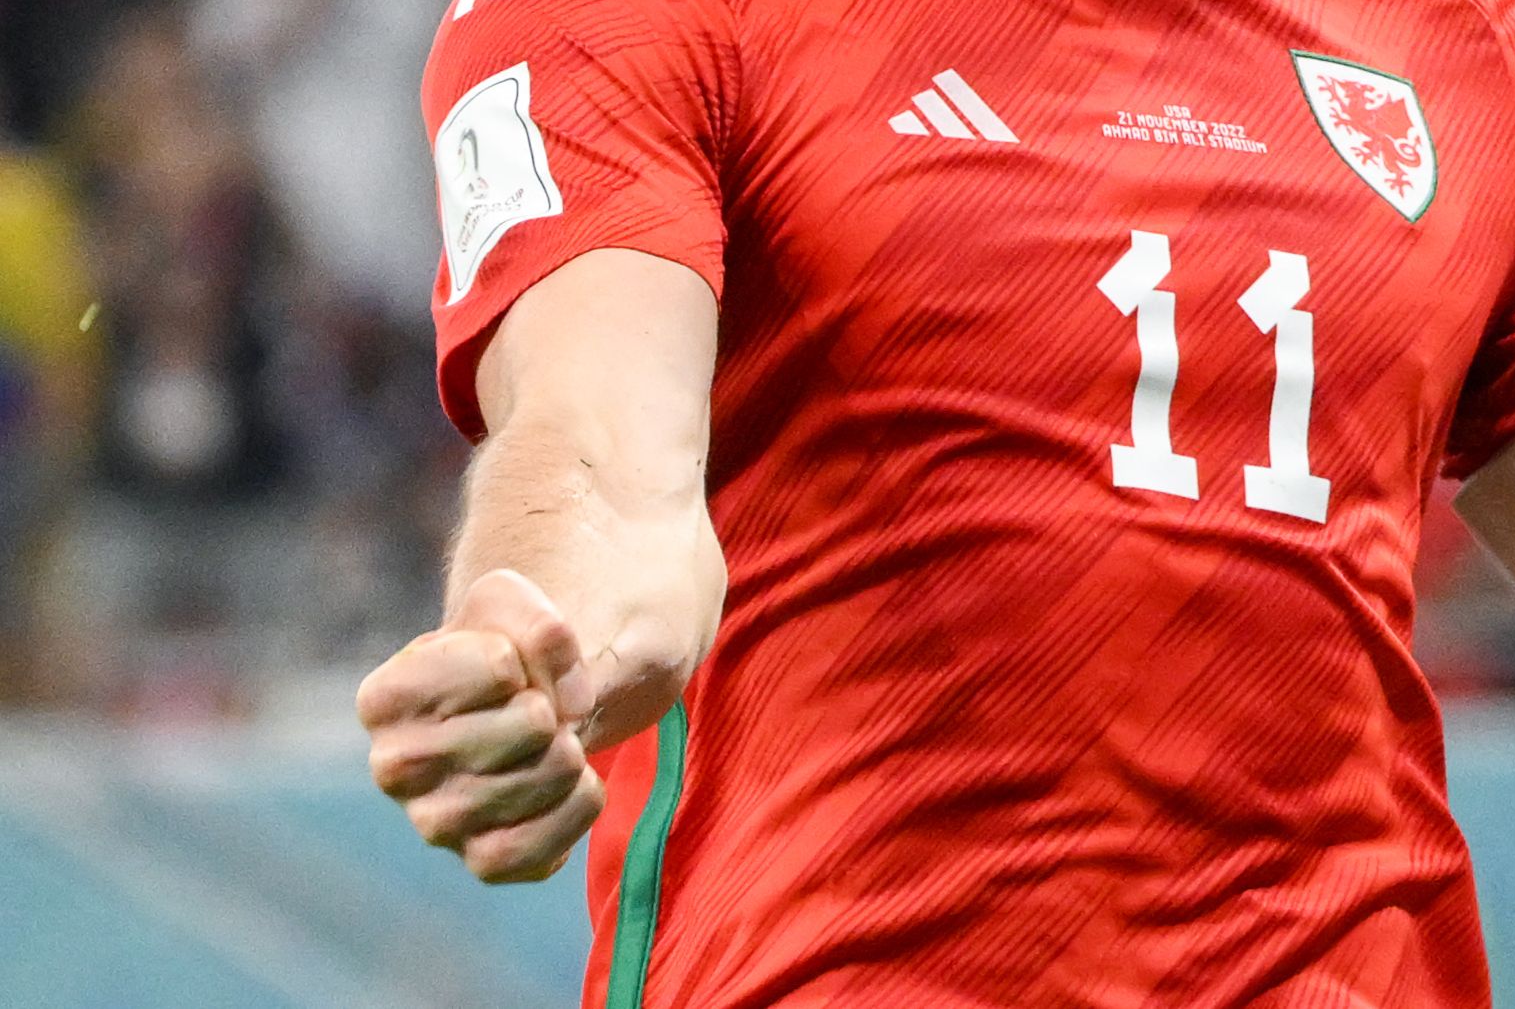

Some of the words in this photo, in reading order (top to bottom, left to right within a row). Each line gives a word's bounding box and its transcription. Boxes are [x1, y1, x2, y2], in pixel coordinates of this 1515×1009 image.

[1117, 111, 1133, 126] 21
[1136, 114, 1209, 133] NOVEMBER
[1211, 122, 1247, 138] 2022
[1163, 104, 1192, 119] USA
[1102, 123, 1150, 141] AHMAD
[1153, 130, 1179, 144] BIN
[1182, 132, 1206, 147] ALI
[1207, 135, 1268, 154] STADIUM
[1096, 229, 1331, 524] 11
